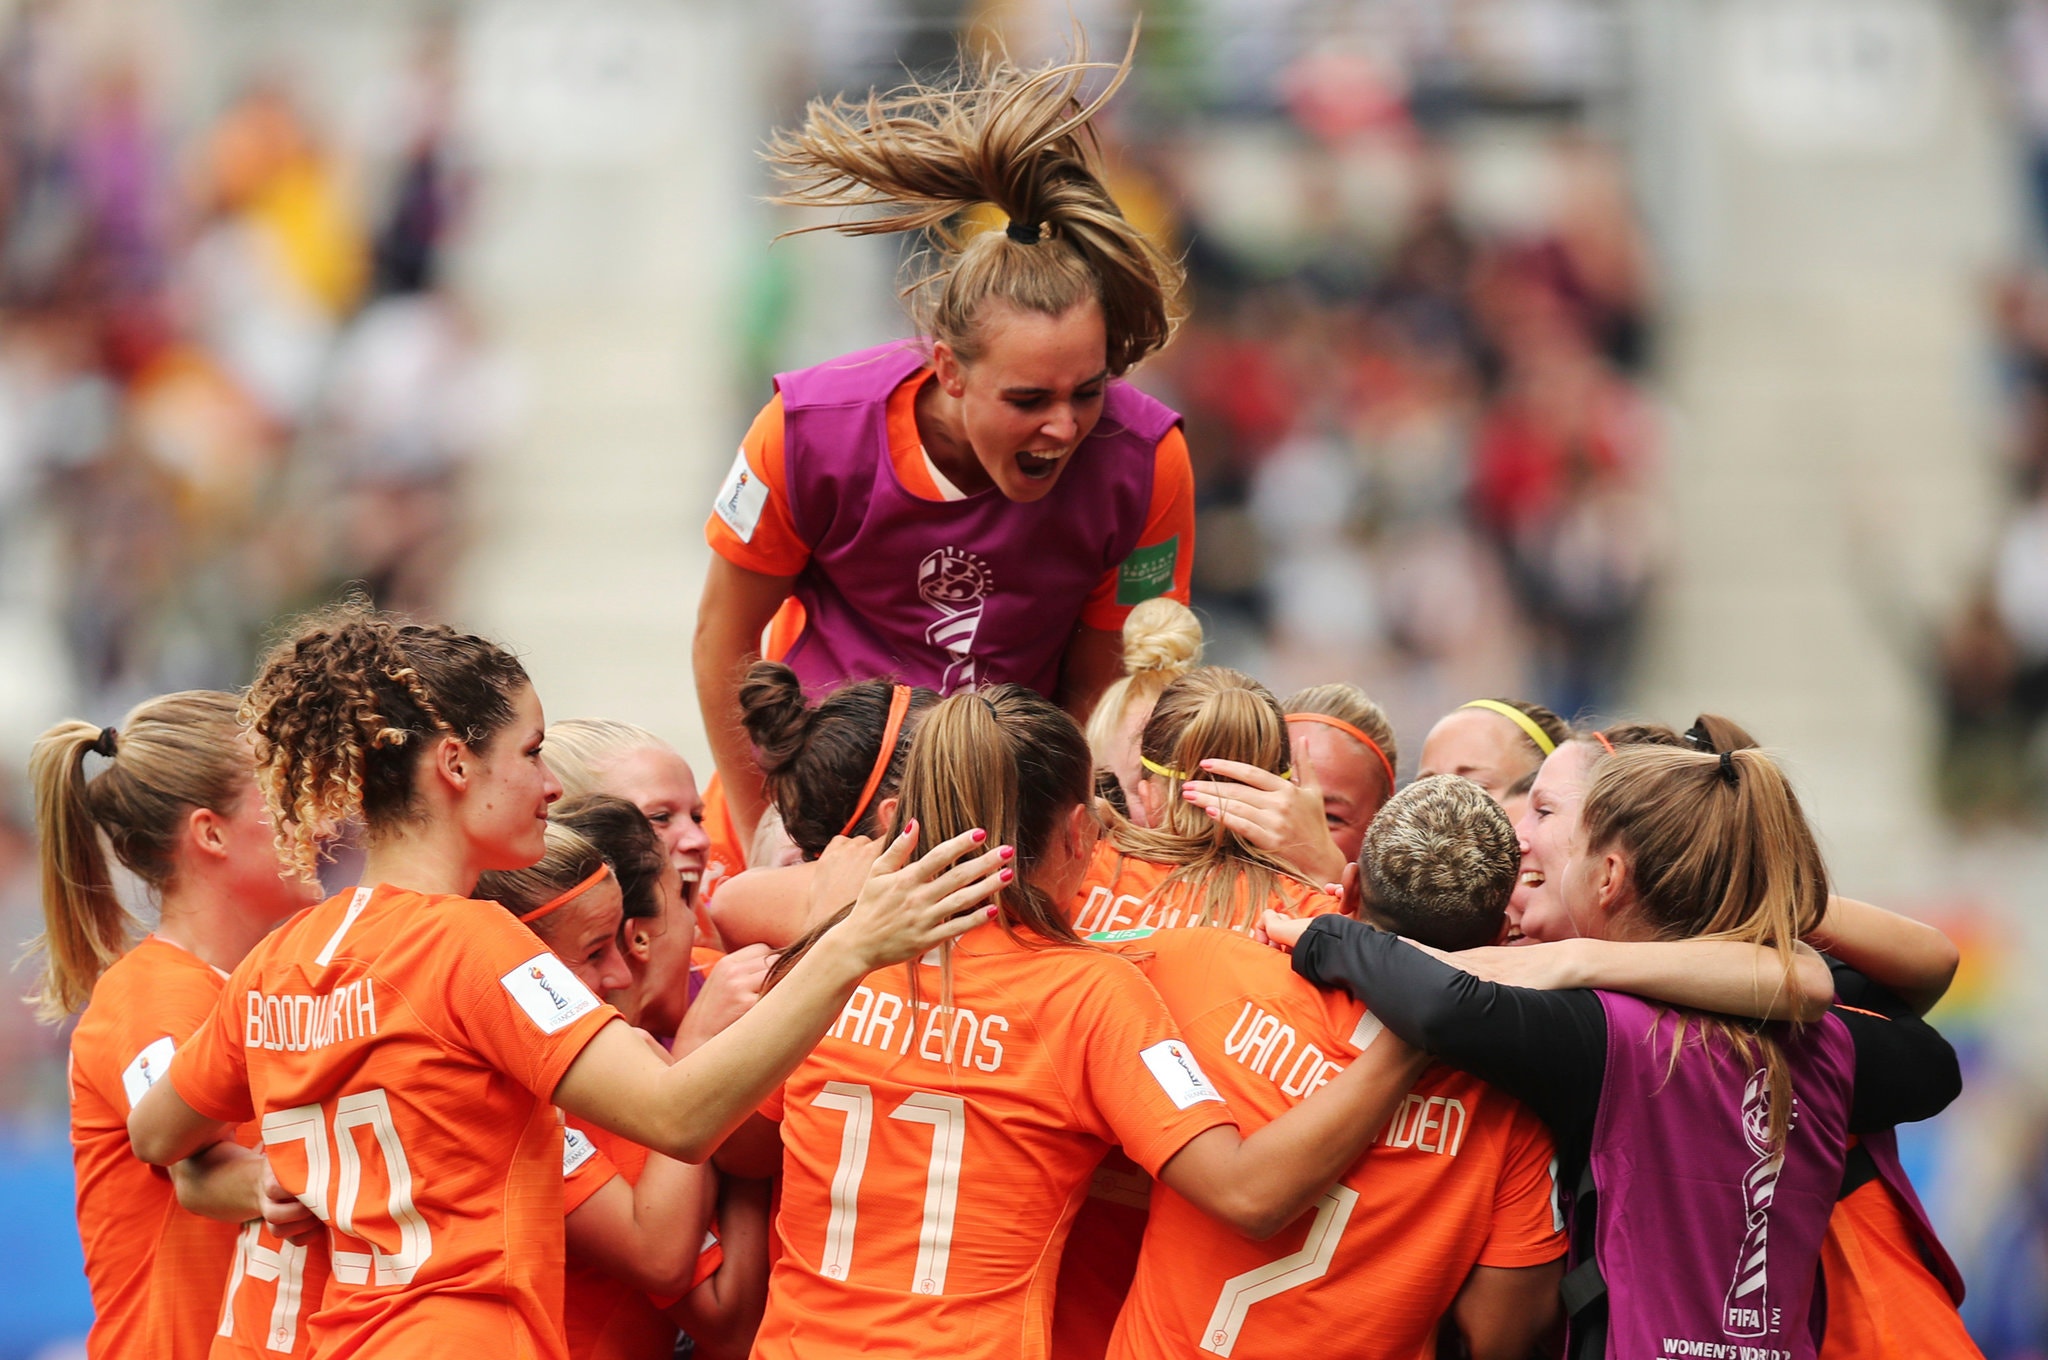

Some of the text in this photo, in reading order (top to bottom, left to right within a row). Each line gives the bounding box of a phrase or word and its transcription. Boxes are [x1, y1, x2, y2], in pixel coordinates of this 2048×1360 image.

[825, 985, 1009, 1073] ARTENS
[1224, 1001, 1296, 1082] VAN
[809, 1080, 966, 1296] 11
[1663, 1337, 1737, 1359] WOMEN'S
[1728, 1307, 1761, 1328] FIFA
